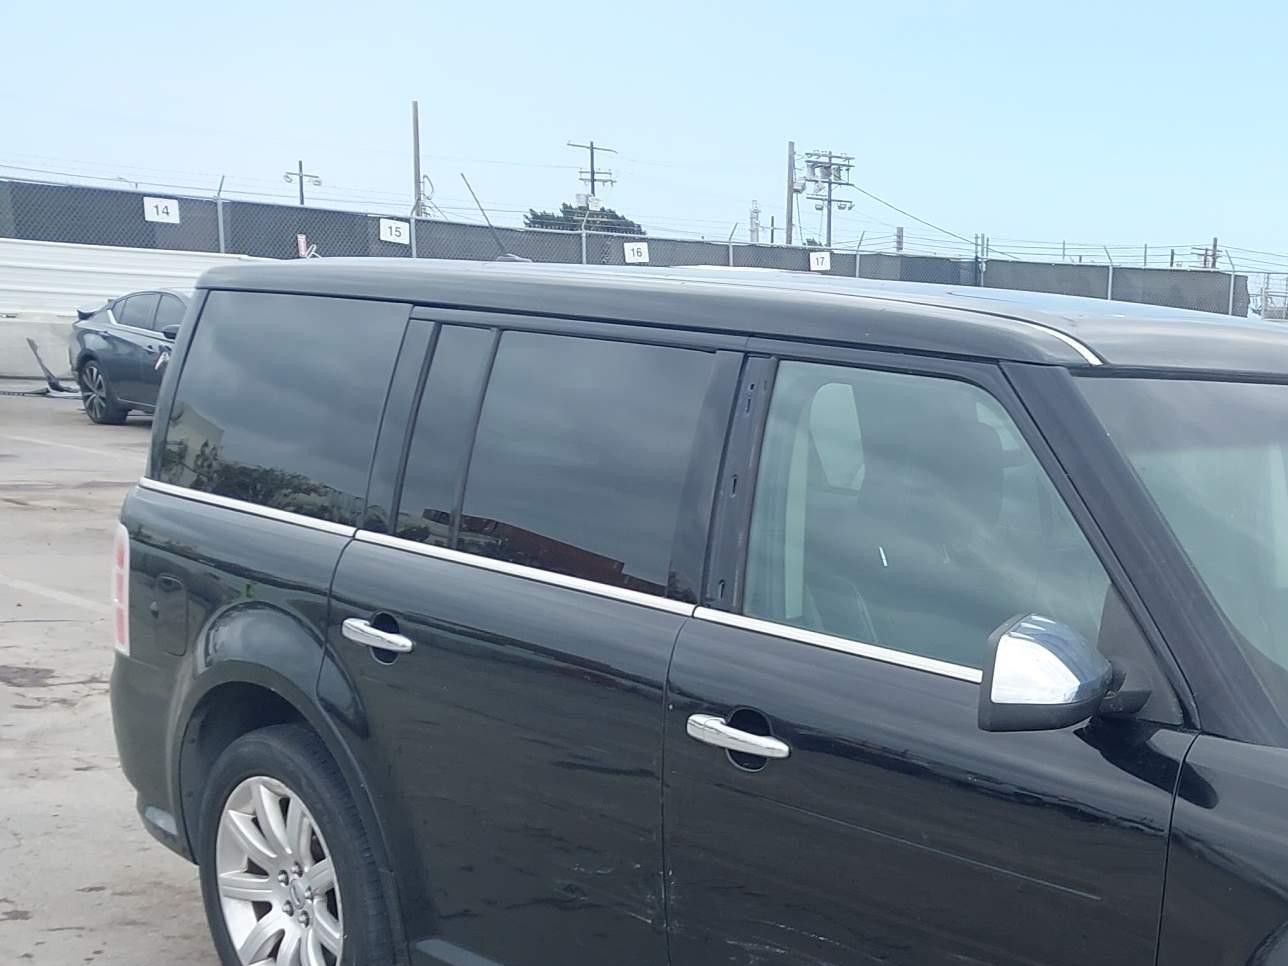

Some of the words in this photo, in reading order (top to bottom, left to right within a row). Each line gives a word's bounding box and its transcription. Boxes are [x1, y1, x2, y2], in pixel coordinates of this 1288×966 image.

[152, 204, 170, 216] 14
[387, 225, 402, 238] 15
[629, 247, 643, 258] 16
[815, 256, 825, 266] 17
